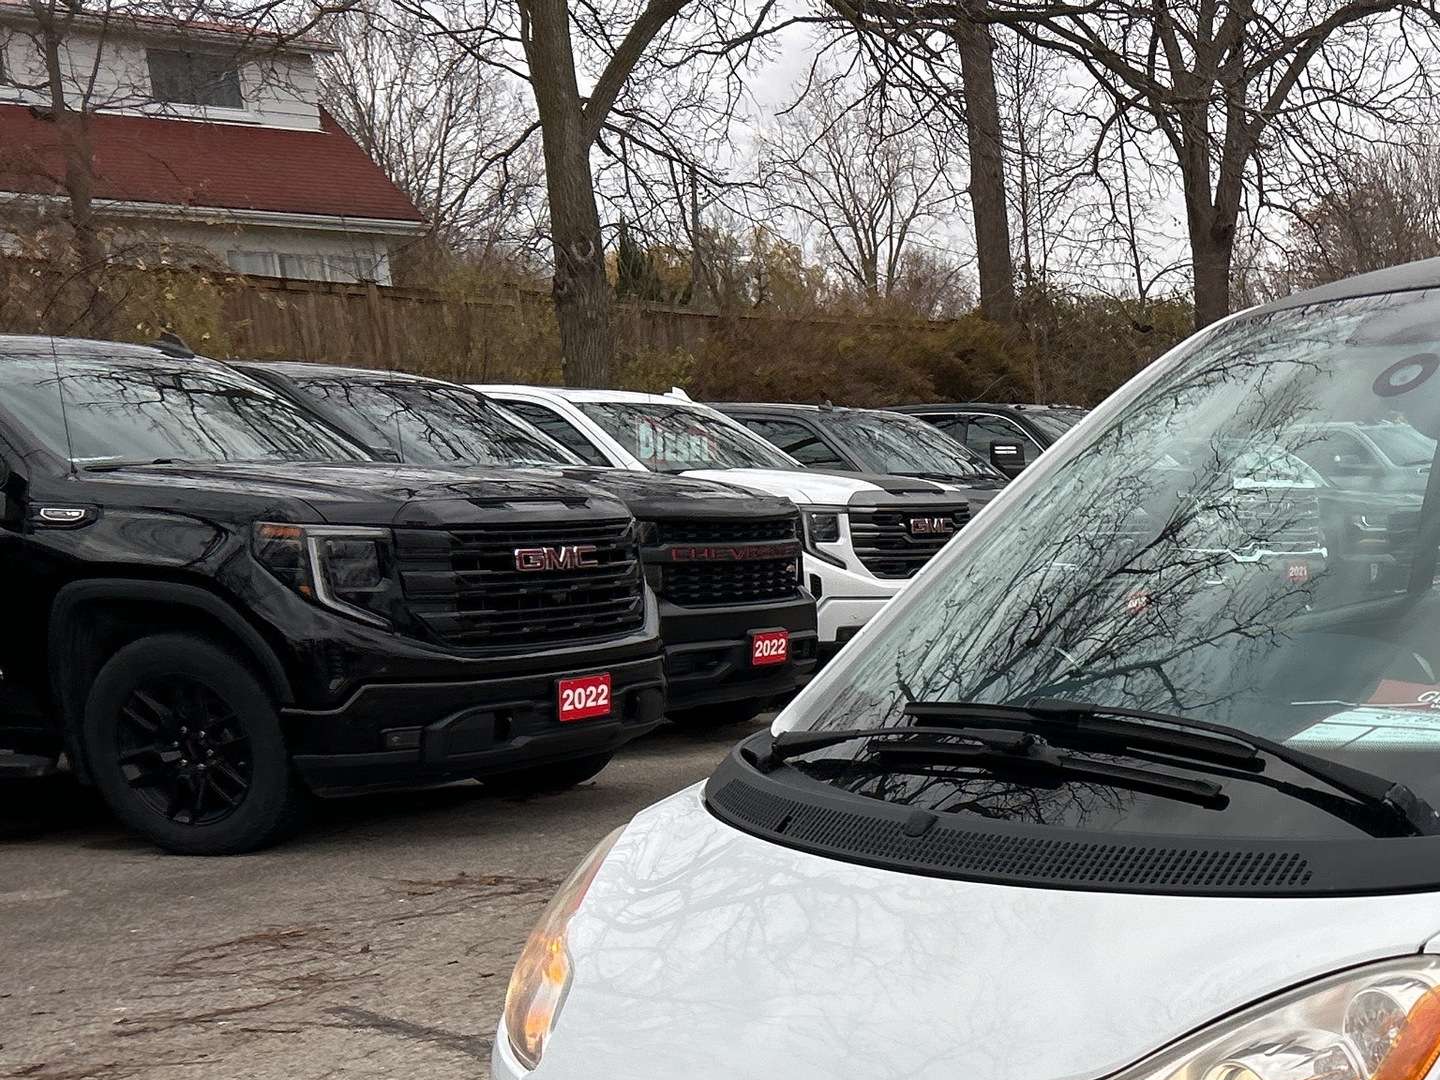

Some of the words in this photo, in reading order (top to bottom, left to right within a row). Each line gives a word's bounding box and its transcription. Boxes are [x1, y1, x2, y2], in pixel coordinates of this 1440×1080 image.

[910, 518, 953, 534] GMC
[514, 545, 598, 571] GMC
[754, 638, 786, 657] 2022
[562, 684, 609, 711] 2022
